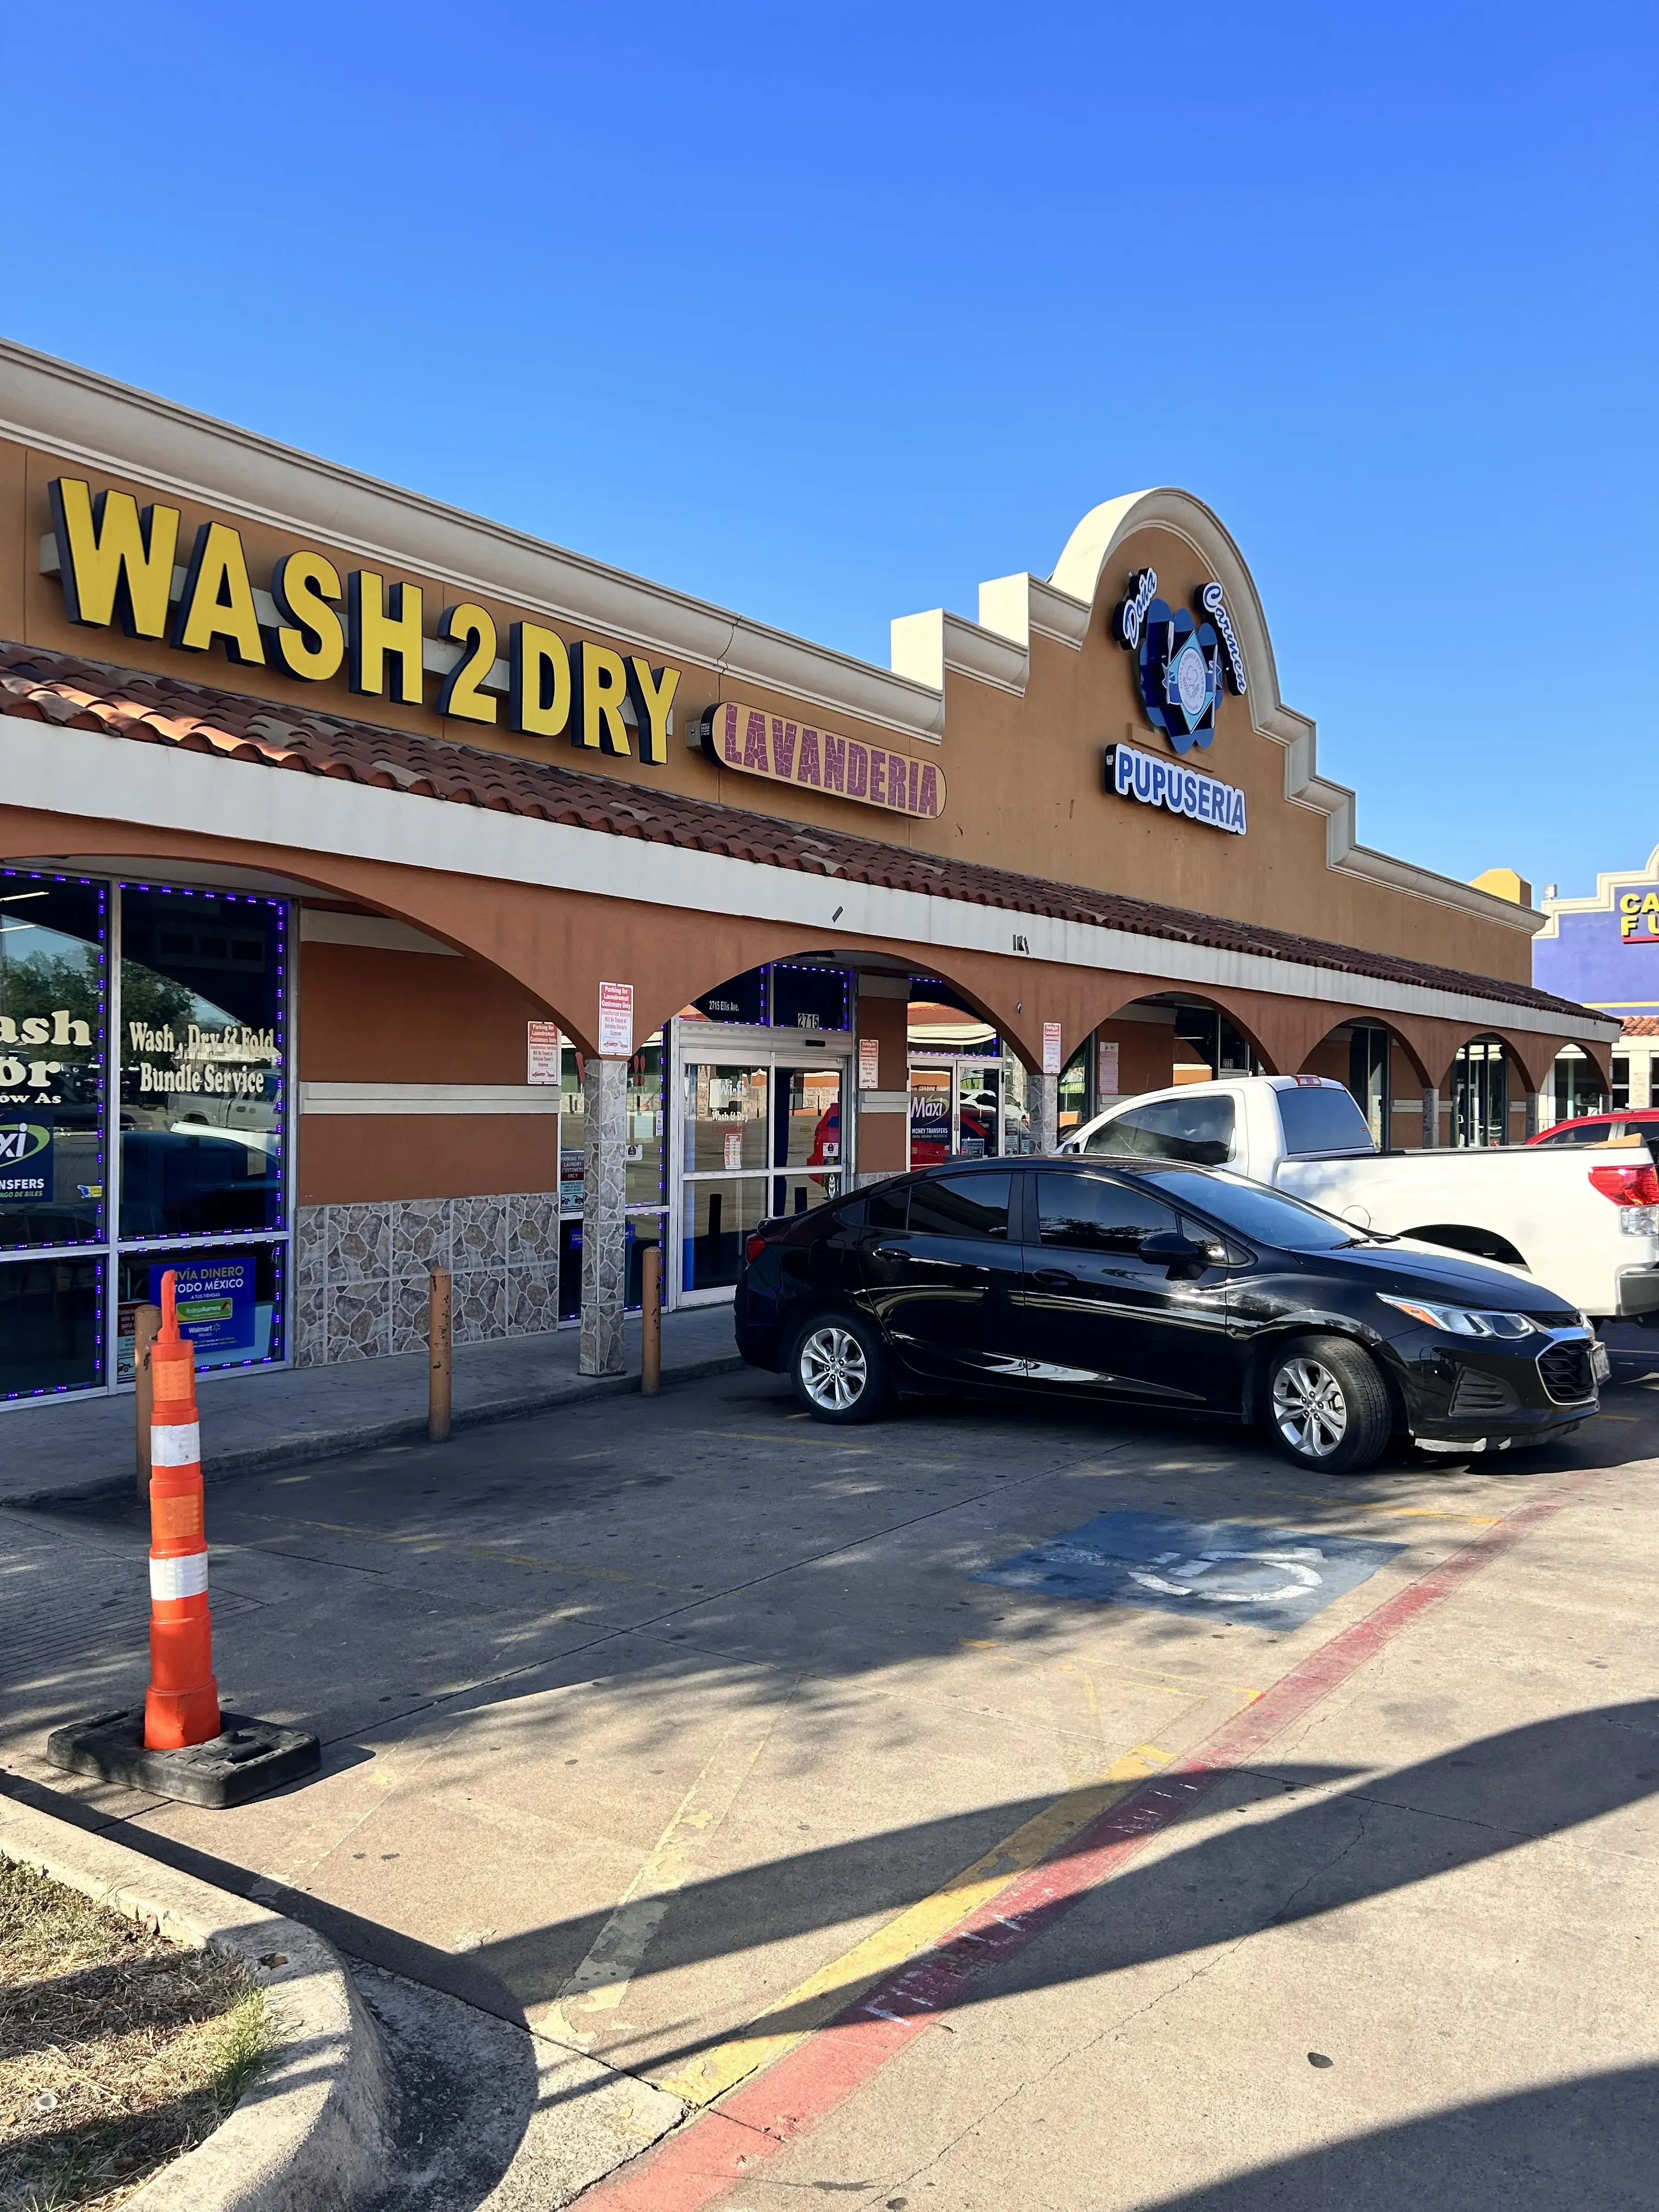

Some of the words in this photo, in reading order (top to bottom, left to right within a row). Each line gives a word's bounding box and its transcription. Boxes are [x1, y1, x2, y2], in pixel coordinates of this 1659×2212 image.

[48, 477, 424, 706] WASH
[436, 602, 498, 725] 2
[510, 620, 682, 766] DRY
[1204, 583, 1246, 693] Carmen
[724, 703, 938, 817] LAVANDERIA
[1118, 749, 1245, 831] PUPUSERIA
[605, 986, 621, 995] Parking
[709, 1000, 720, 1011] 2715
[799, 1013, 819, 1028] 2715
[129, 1022, 174, 1052] Wash
[188, 1024, 220, 1054] Dry
[223, 1025, 238, 1053] &
[241, 1027, 274, 1054] Fold
[140, 1063, 201, 1092] Bundle
[204, 1064, 264, 1093] Service
[35, 1093, 61, 1103] As
[712, 1109, 729, 1121] Wash
[730, 1111, 736, 1120] &
[737, 1111, 748, 1122] Dry
[911, 1097, 943, 1118] Maxi
[174, 1267, 198, 1281] VÍA
[201, 1266, 244, 1279] DINERO
[205, 1278, 244, 1291] MÉXICO
